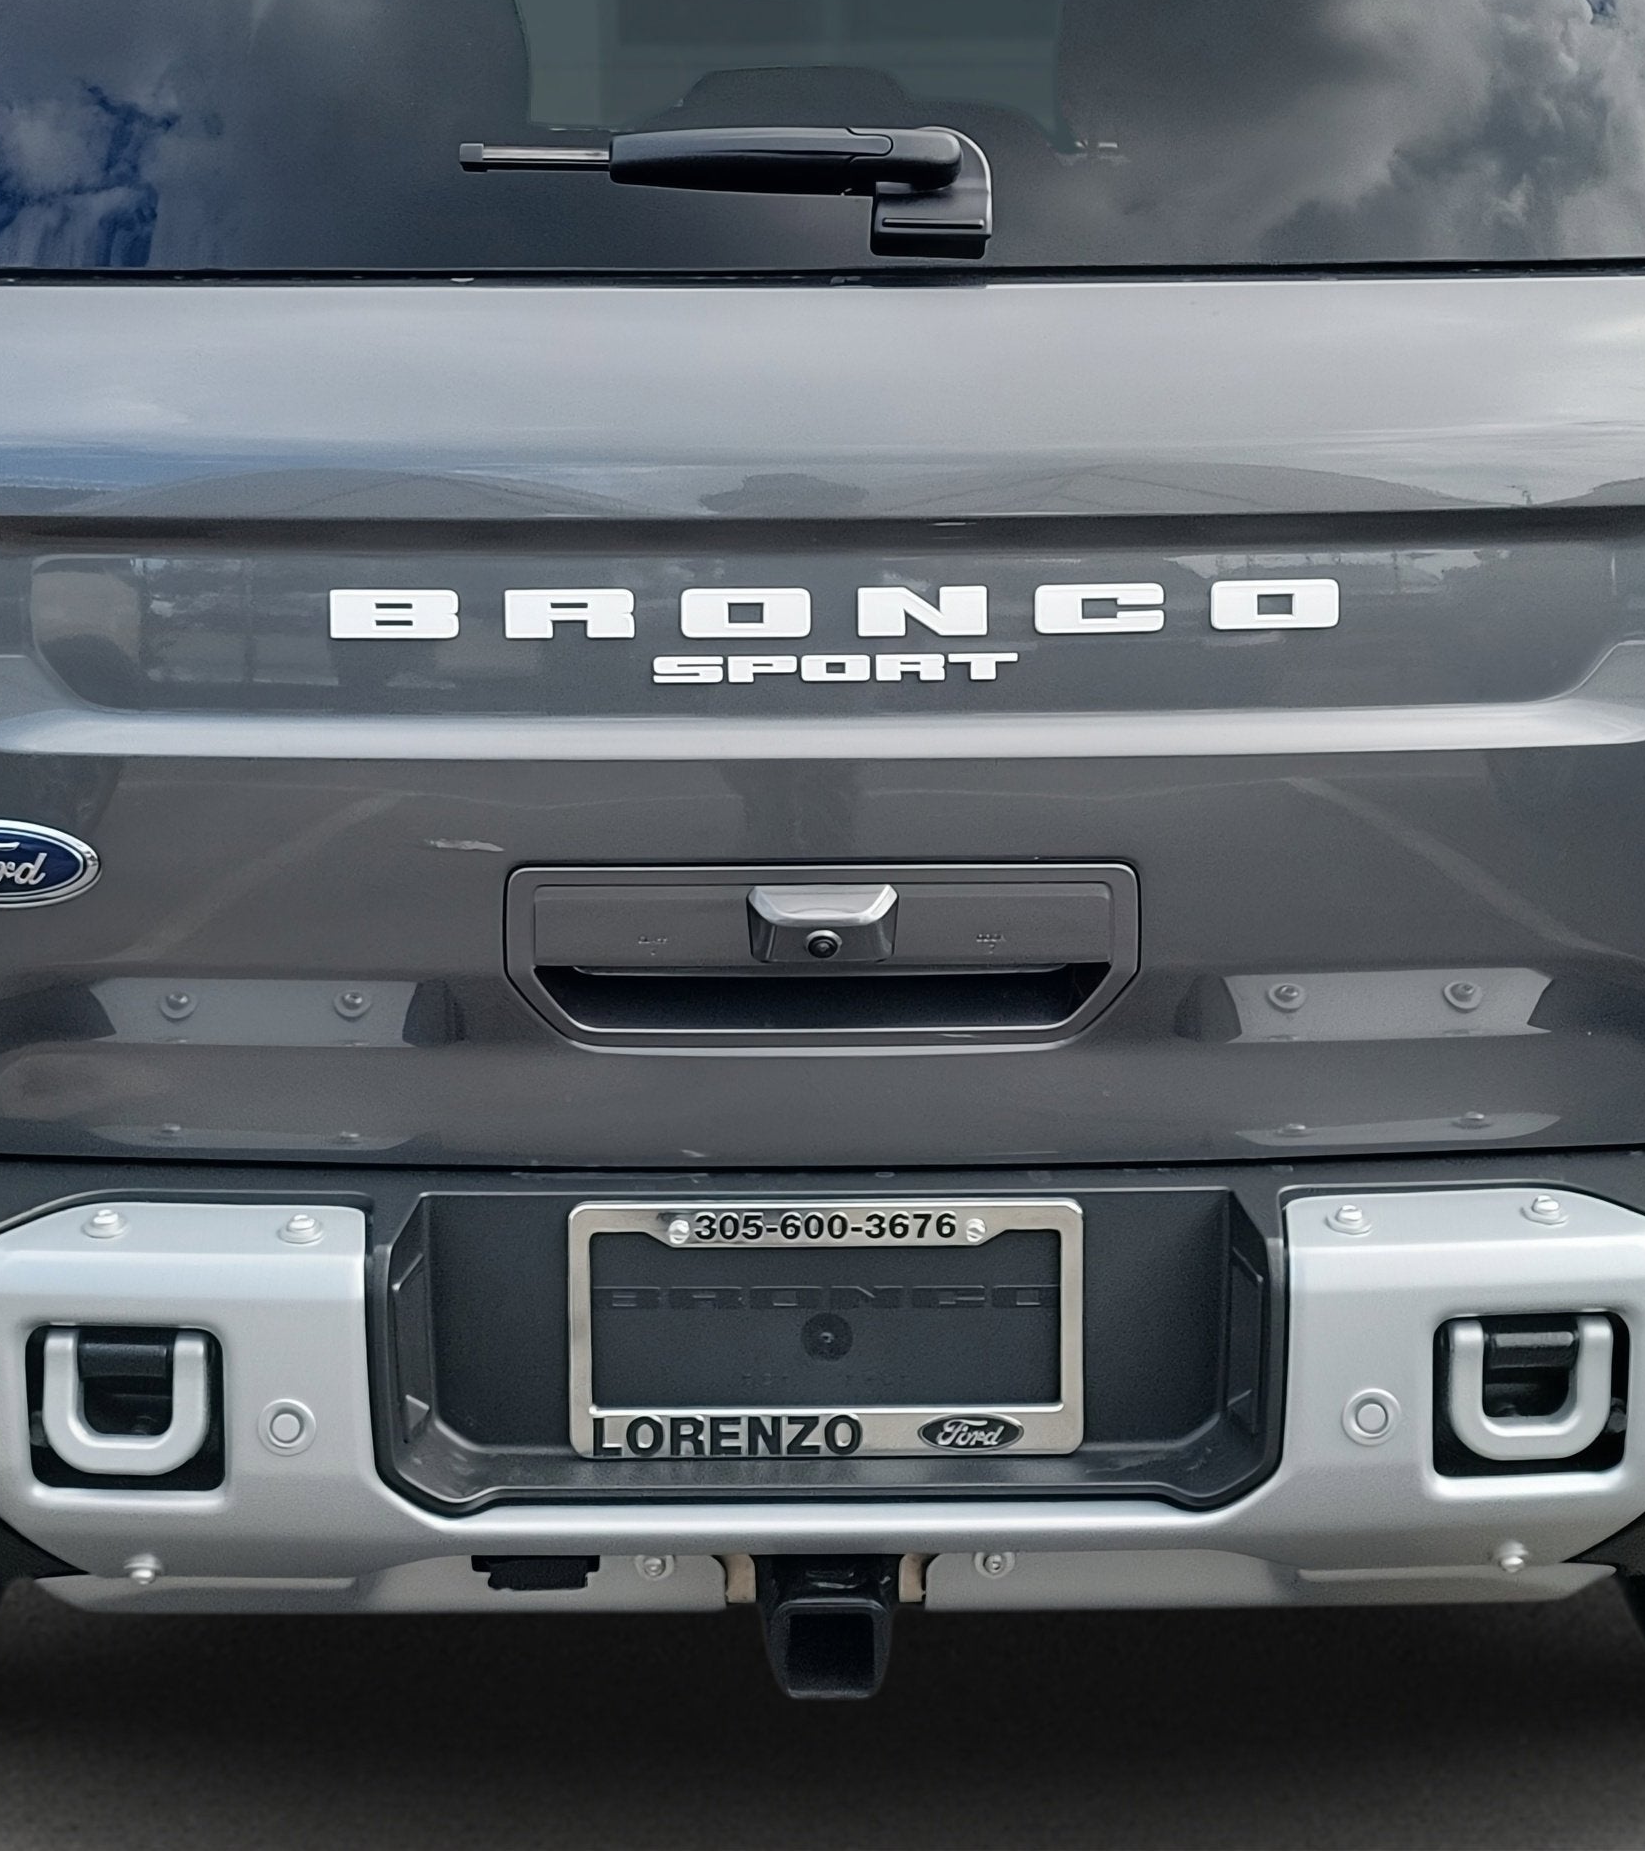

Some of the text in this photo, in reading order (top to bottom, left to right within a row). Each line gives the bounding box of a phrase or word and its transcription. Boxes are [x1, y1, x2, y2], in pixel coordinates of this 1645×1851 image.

[328, 578, 1341, 640] BRONCO
[652, 652, 1019, 684] SPORT
[692, 1212, 958, 1241] 305-600-3676
[592, 1414, 1006, 1457] LORENZO Ford
